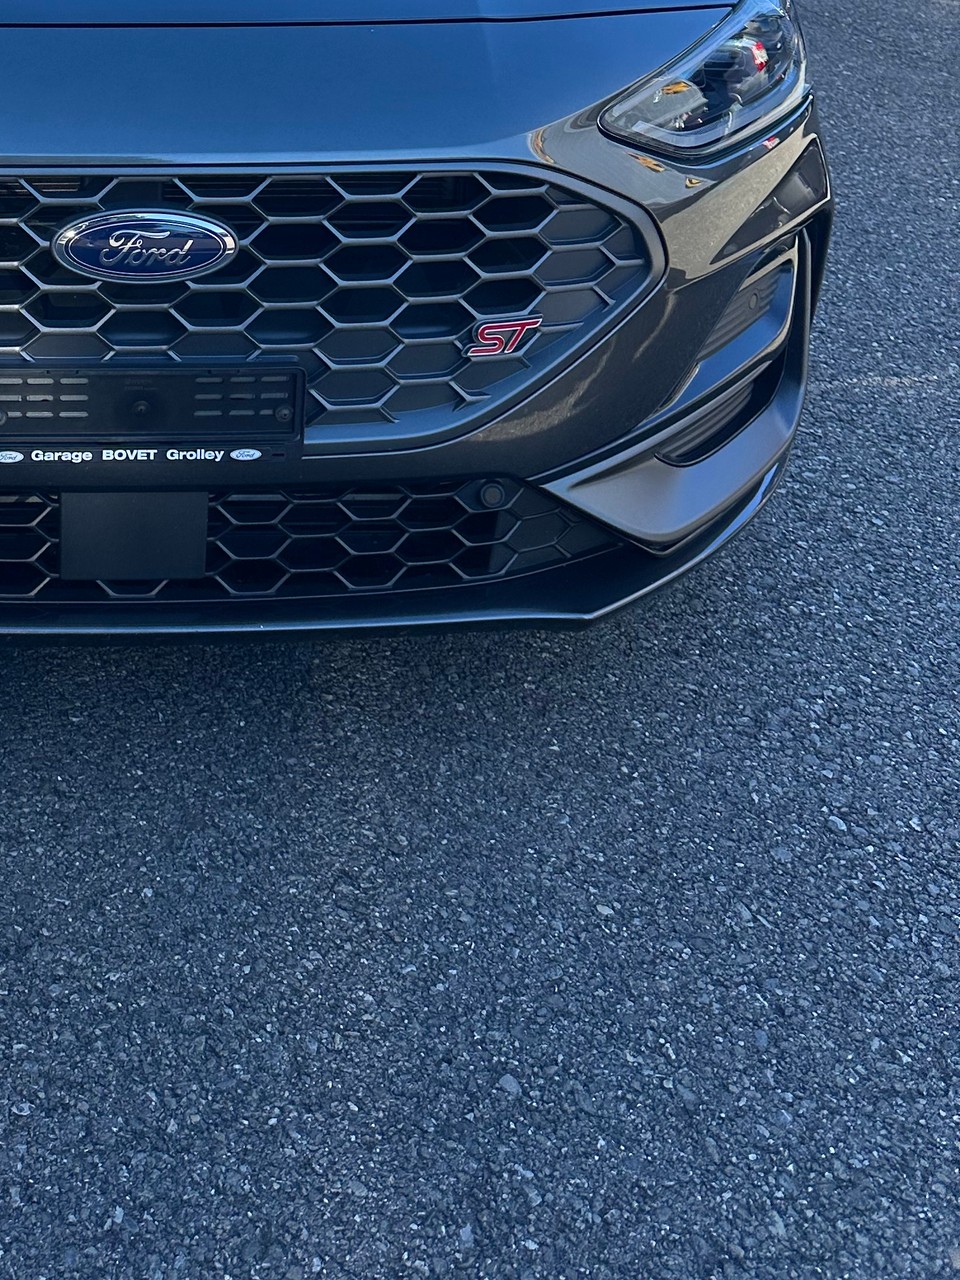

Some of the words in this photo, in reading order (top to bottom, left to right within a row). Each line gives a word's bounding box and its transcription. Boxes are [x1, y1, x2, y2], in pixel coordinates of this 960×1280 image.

[100, 230, 194, 266] Ford
[468, 318, 542, 356] ST
[31, 449, 93, 463] Garage
[102, 449, 158, 461] BOVET
[166, 449, 225, 462] Grolley
